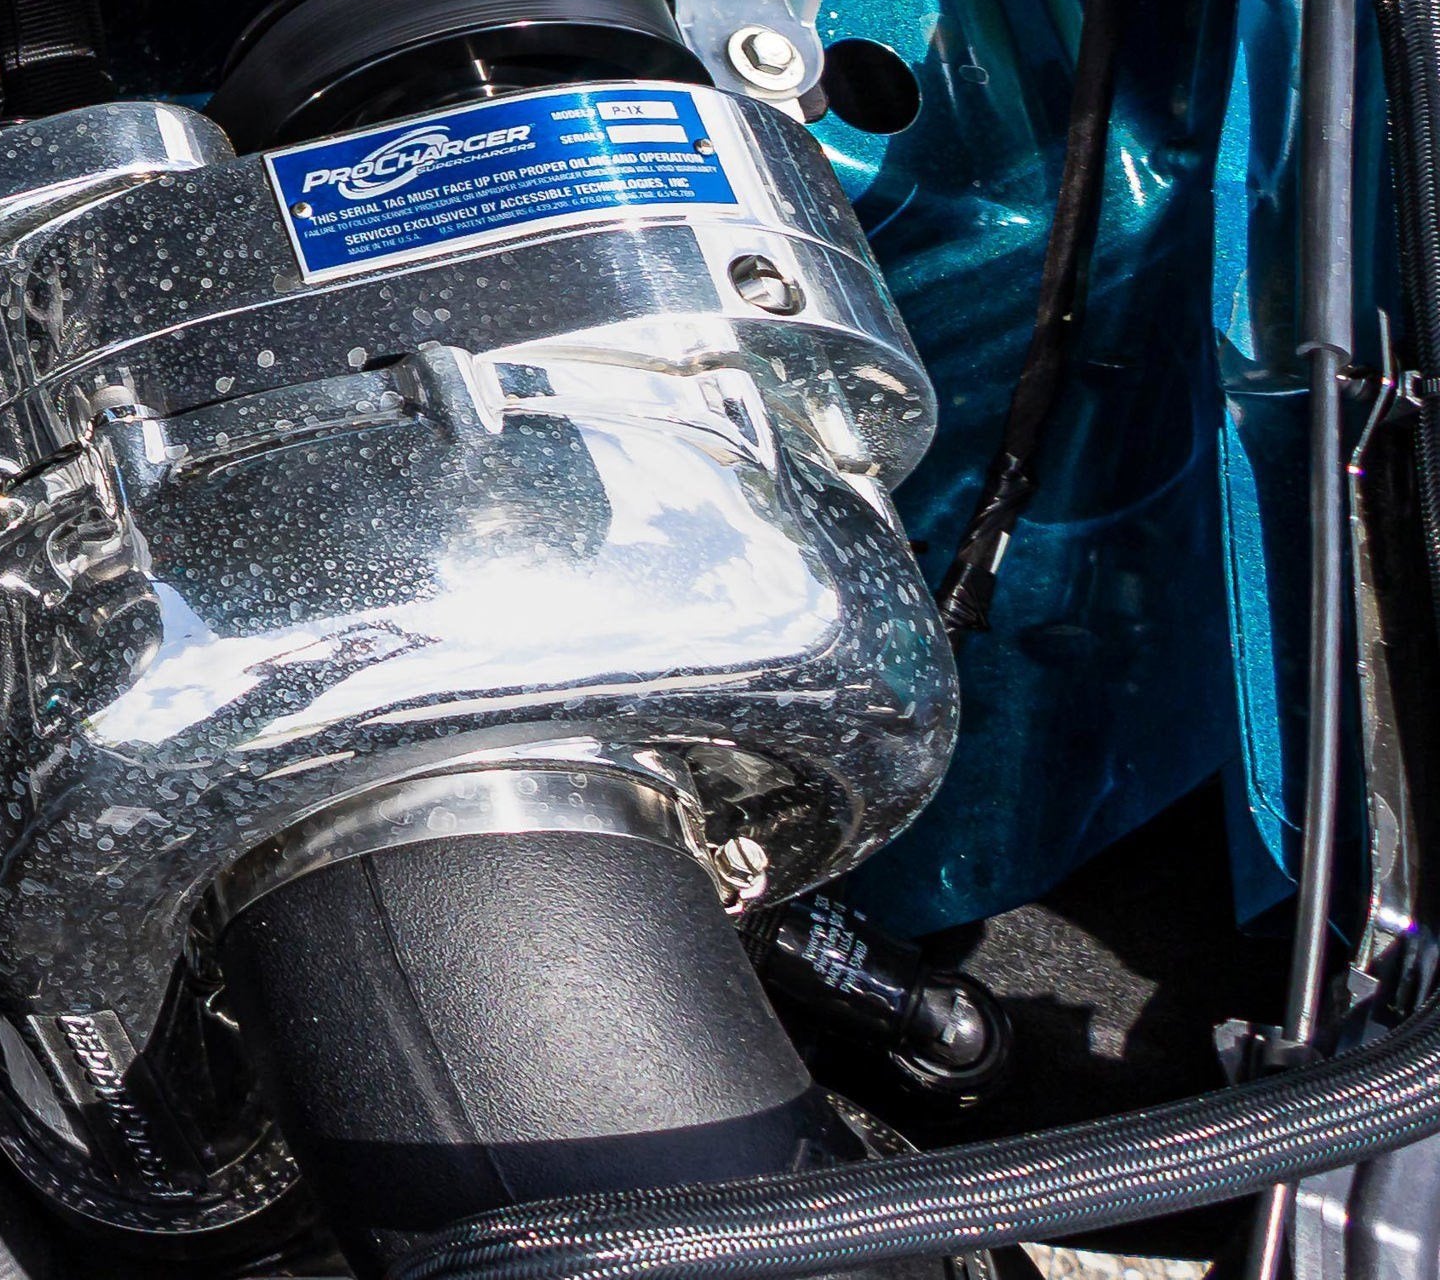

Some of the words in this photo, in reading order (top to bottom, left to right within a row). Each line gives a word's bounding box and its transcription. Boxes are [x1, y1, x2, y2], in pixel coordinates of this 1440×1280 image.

[612, 105, 644, 116] P-1X
[416, 142, 536, 175] SUPERCHARGERS
[304, 224, 338, 239] FAILURE
[338, 221, 349, 231] TO
[349, 215, 381, 229] FOLLOW
[381, 208, 414, 221] SERVICE
[415, 197, 463, 214] PROCEDURE
[475, 182, 517, 199] IMPROPER
[518, 170, 582, 189] SUPERCHARGER
[310, 213, 338, 227] THIS
[341, 202, 382, 220] SERIAL
[383, 196, 405, 209] TAG
[408, 189, 441, 204] MUST
[442, 182, 473, 197] FACE
[475, 177, 492, 189] UP
[494, 169, 518, 185] FOR
[519, 161, 568, 179] PROPER
[569, 153, 613, 170] OILING
[612, 151, 638, 166] AND
[639, 151, 705, 165] OPERATION
[344, 225, 402, 247] SERVICED
[404, 208, 479, 233] EXCLUSIVELY
[482, 201, 497, 214] BY
[500, 185, 573, 210] ACCESSIBLE
[669, 177, 690, 188] INC
[456, 217, 486, 231] PATENT
[487, 208, 528, 224] NUMBERS
[347, 244, 372, 256] MADE
[373, 241, 382, 252] IN
[382, 237, 397, 249] THE
